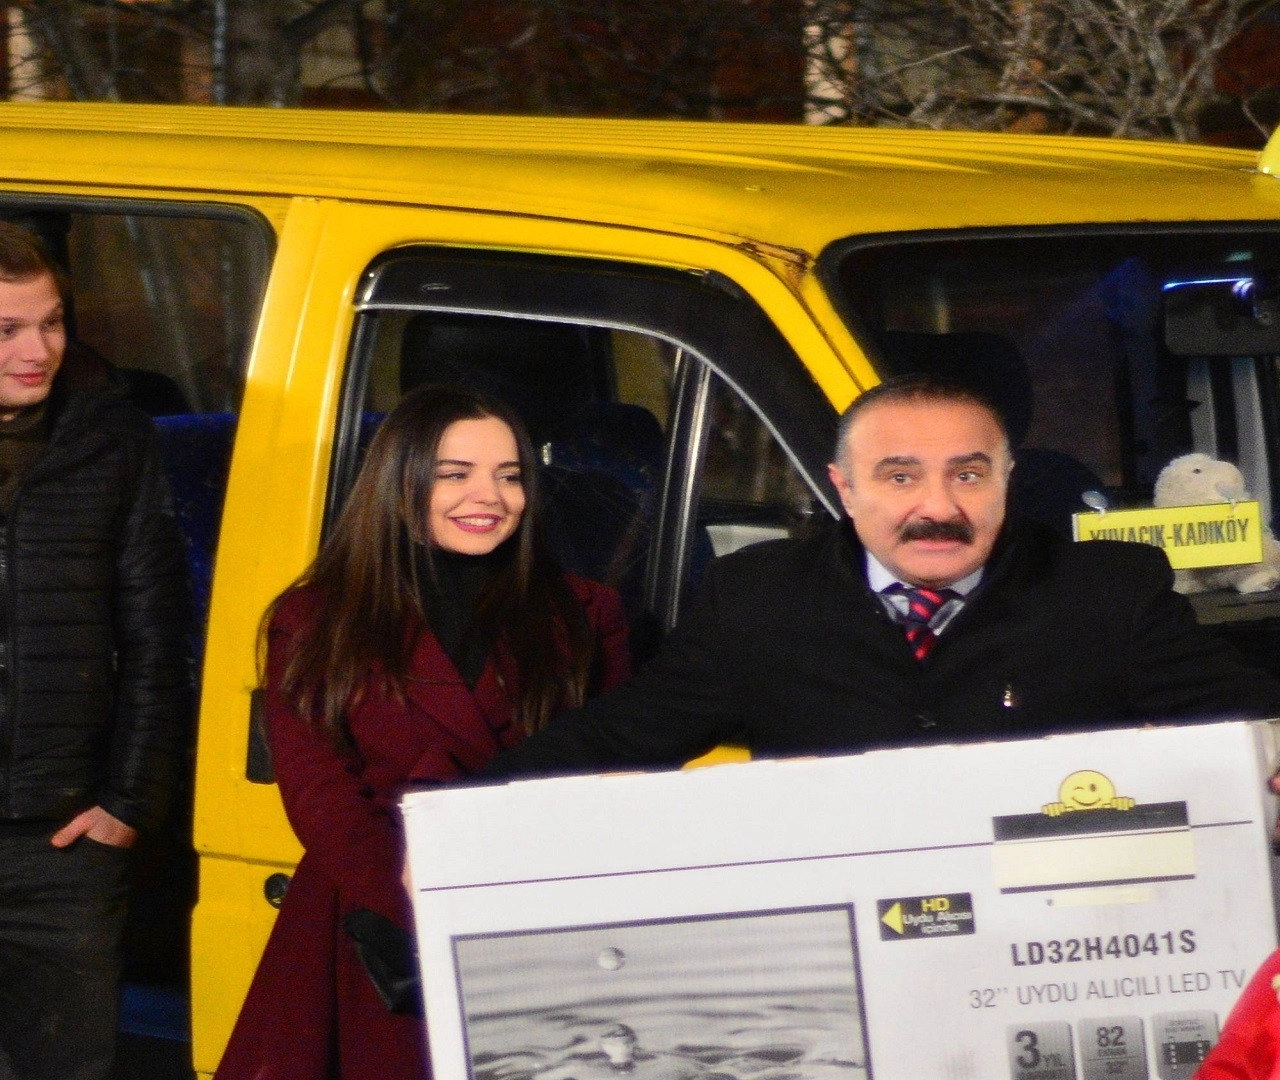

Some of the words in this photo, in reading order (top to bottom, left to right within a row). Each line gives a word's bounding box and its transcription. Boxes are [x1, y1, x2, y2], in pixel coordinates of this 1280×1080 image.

[921, 897, 950, 912] HD
[1010, 929, 1198, 967] LD32H4041S
[1016, 981, 1078, 1005] UYDU
[1086, 975, 1161, 1000] ALICILI
[1168, 972, 1211, 994] LED
[1218, 969, 1246, 989] TV
[1015, 1029, 1041, 1069] 3
[1096, 1025, 1126, 1048] 82
